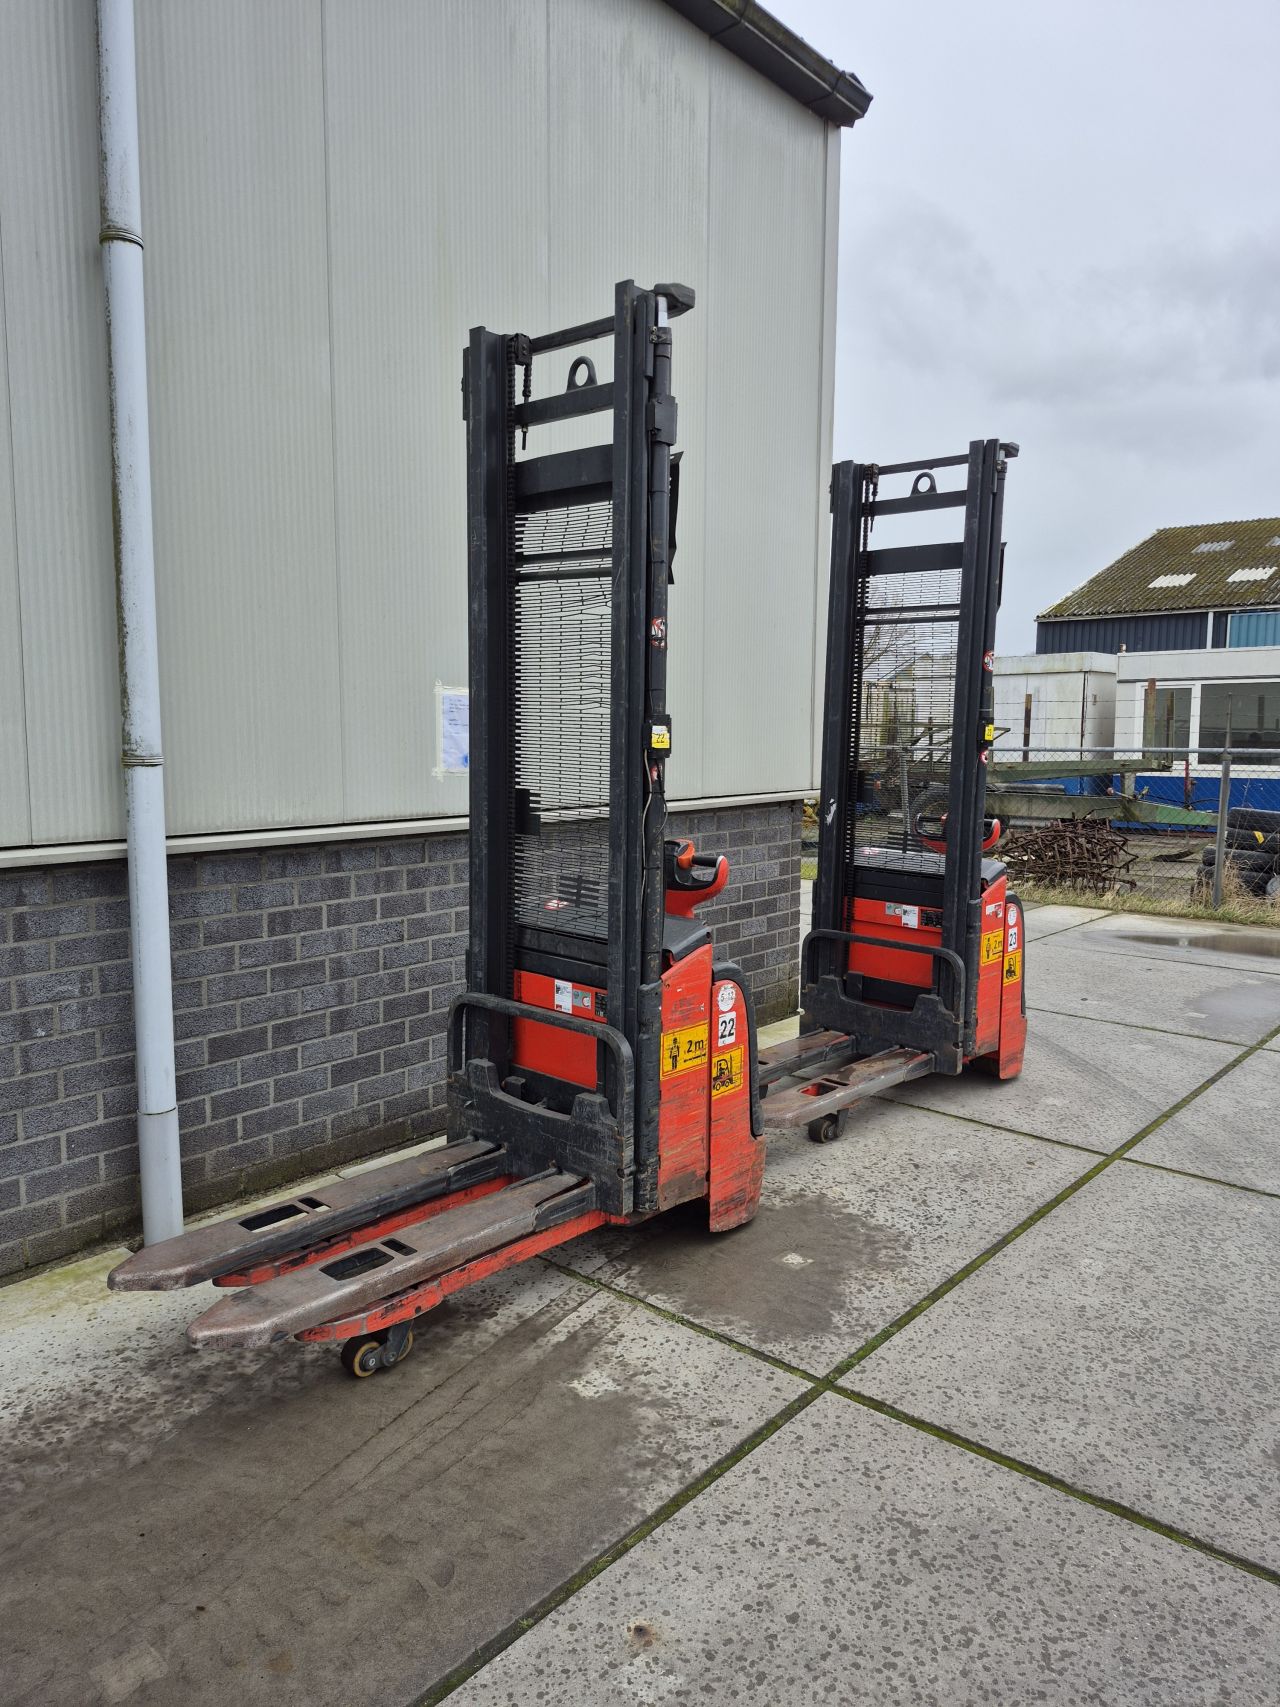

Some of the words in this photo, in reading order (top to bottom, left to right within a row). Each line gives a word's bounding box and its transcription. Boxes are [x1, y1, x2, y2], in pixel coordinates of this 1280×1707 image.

[656, 733, 664, 743] 22
[1009, 932, 1016, 946] 23
[720, 1018, 734, 1039] 22
